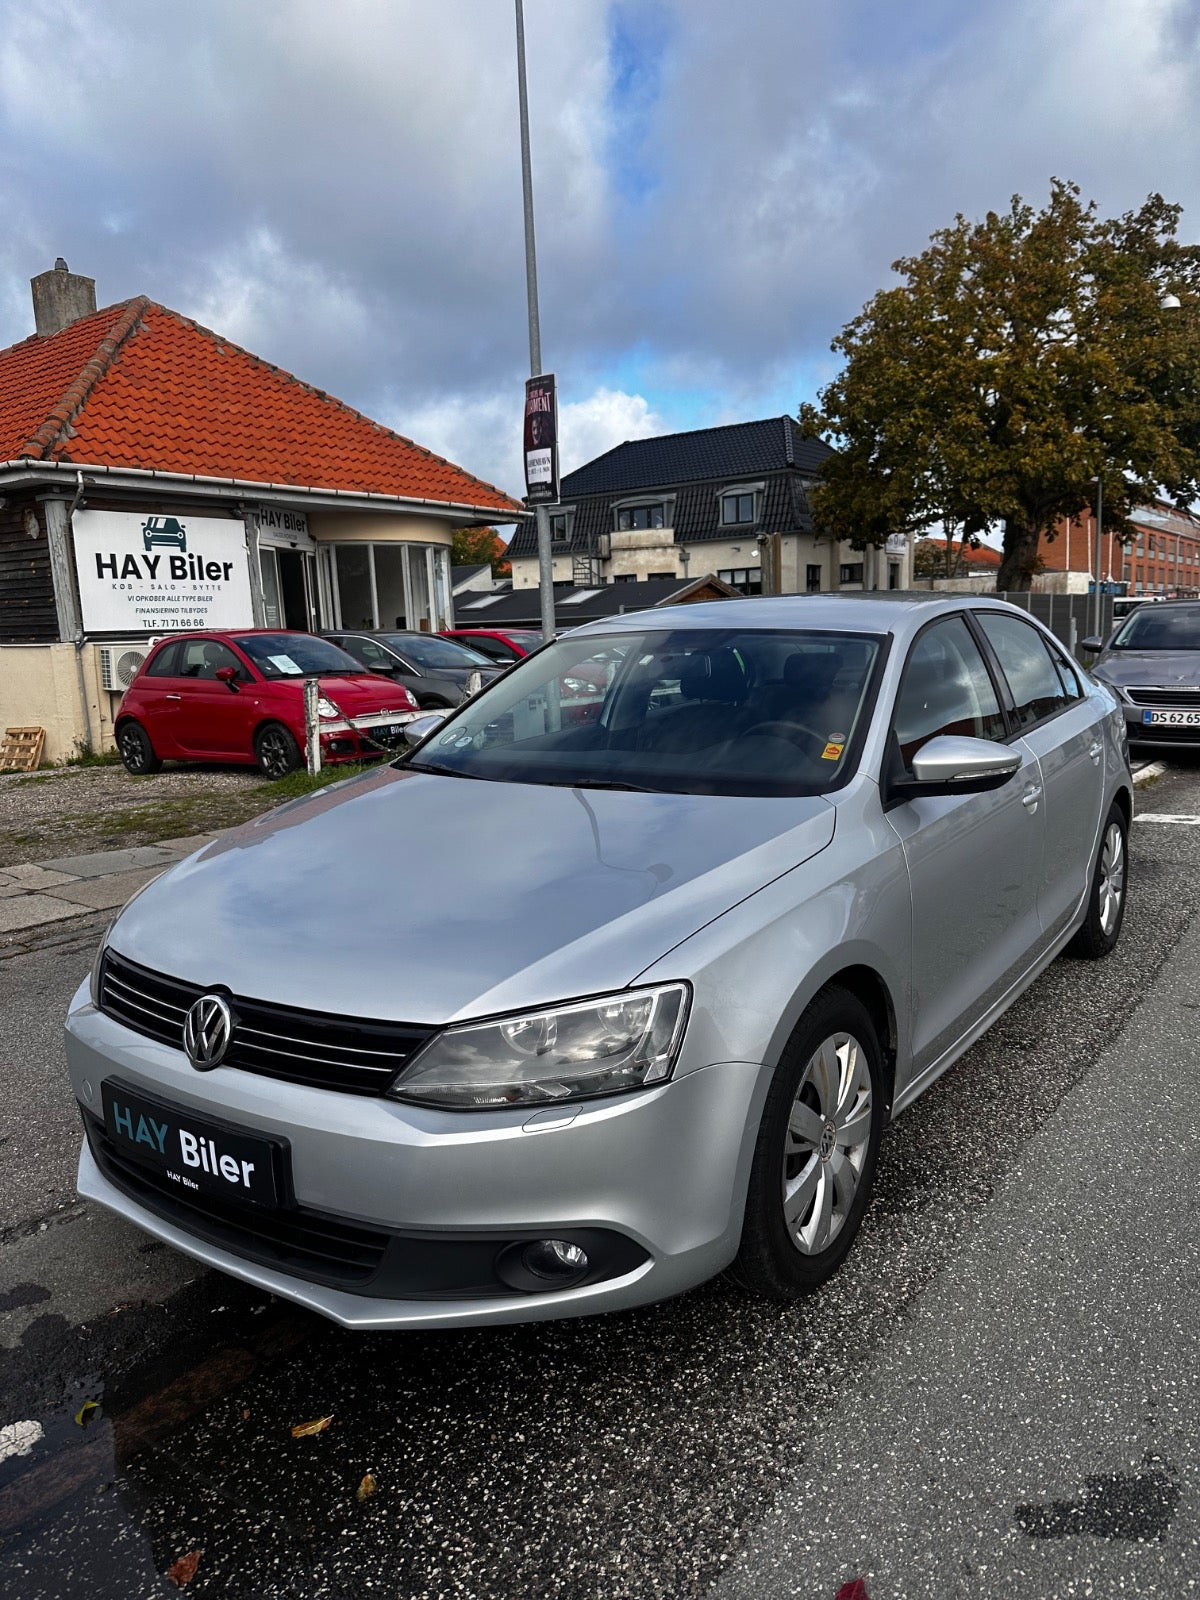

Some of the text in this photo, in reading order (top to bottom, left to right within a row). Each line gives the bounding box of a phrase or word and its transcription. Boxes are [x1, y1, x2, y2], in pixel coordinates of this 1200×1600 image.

[260, 508, 305, 533] HAY Biler
[95, 552, 233, 582] HAY Biler
[142, 618, 205, 628] TLF. 71 71 66 66
[1151, 713, 1167, 723] DS
[1169, 713, 1184, 724] 62
[113, 1101, 254, 1188] HAY Biler
[166, 1170, 199, 1190] HAY Biler
